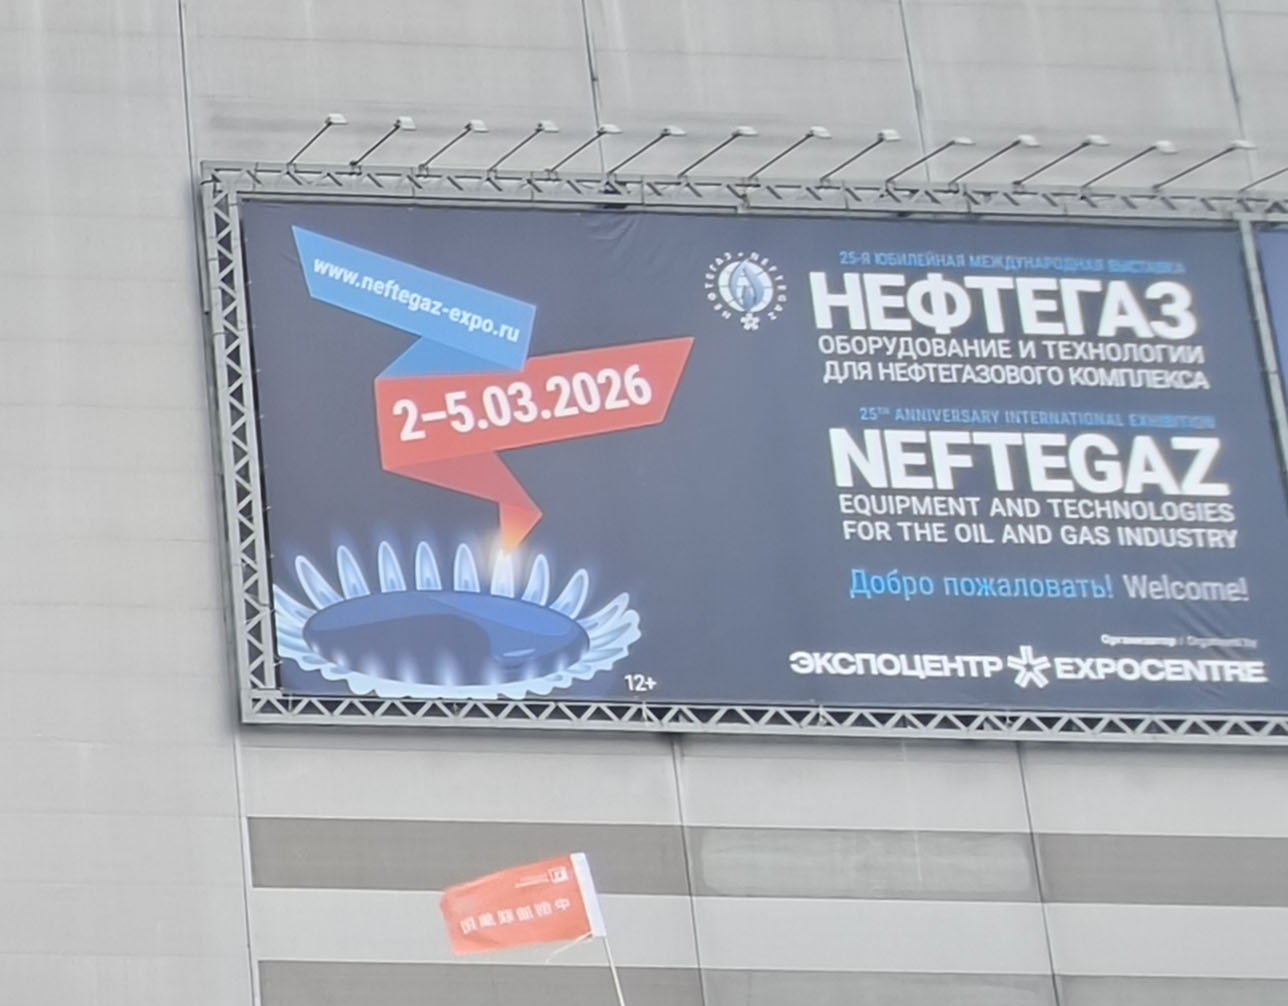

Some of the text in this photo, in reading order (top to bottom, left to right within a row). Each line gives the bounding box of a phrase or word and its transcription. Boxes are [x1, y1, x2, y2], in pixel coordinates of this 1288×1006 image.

[839, 251, 872, 265] 25-Я
[874, 251, 966, 268] ЮБИЛЕЙНАЯ
[313, 257, 520, 342] www.neftegaz-expo.ru
[809, 271, 1197, 340] НЕФТЕГАЗ
[818, 335, 1205, 364] ОБОРУДОВАНИЕ И ТЕХНОЛОГИИ
[823, 360, 1210, 389] ДЛЯ НЕФТЕГАЗОВОГО КОМПЛЕКСА
[894, 407, 1000, 425] ANNIVERSARY
[1004, 410, 1125, 427] INTERNATIONAL
[828, 427, 1231, 497] NEFTEGAZ
[838, 494, 1236, 523] EQUIPMENT AND TECHNOLOGIES
[842, 521, 1239, 549] FOR THE OIL AND GAS INDUSTRY
[849, 569, 1114, 600] Добро пожаловать!
[1122, 574, 1250, 602] Welcome!
[788, 650, 1003, 679] ЭКСПОЦЕНТР
[1054, 657, 1269, 683] EXPOCENTRE
[624, 674, 657, 692] 12+
